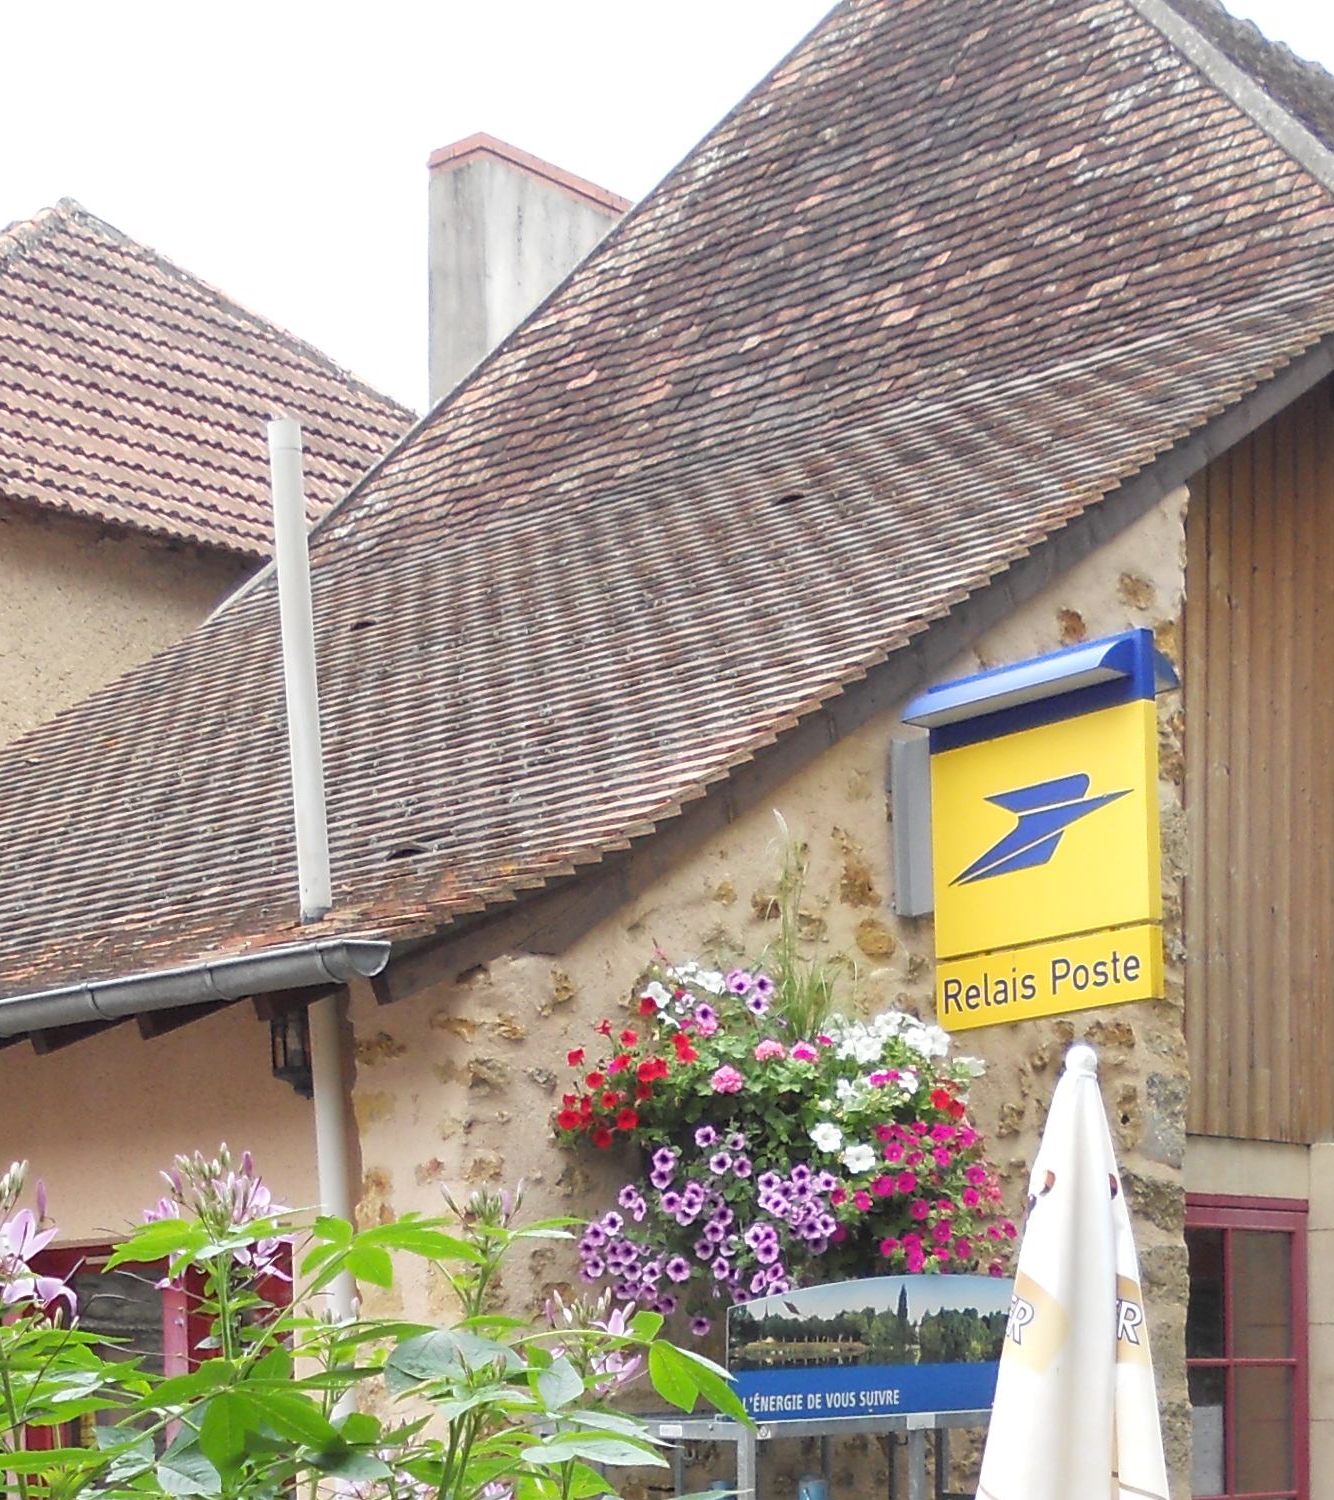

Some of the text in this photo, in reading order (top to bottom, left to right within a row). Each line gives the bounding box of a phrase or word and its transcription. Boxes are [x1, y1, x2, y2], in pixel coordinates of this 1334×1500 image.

[943, 950, 1141, 1016] Relais Poste
[742, 1389, 900, 1413] L'ÉNERGIE DE VOUS SUIVRE
